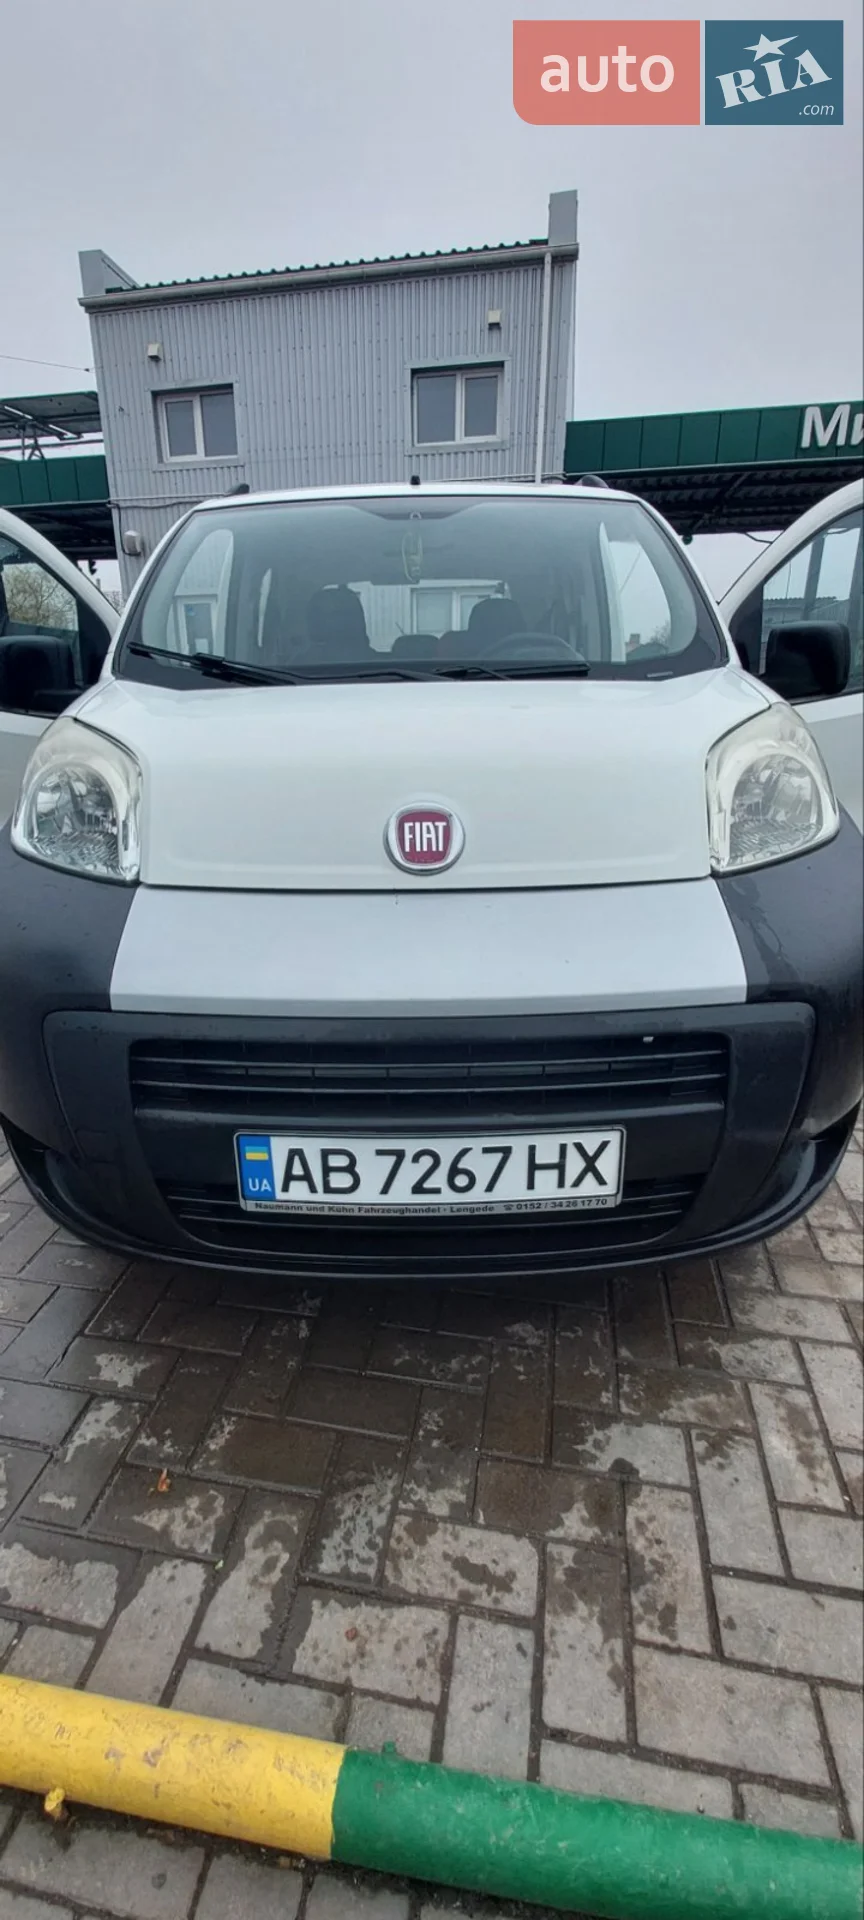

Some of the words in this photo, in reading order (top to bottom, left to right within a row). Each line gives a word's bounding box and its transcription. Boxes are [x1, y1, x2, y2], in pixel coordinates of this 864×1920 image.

[404, 821, 447, 852] FIAT
[281, 1148, 361, 1194] AB
[375, 1146, 513, 1195] 7267
[526, 1140, 610, 1190] HX
[248, 1178, 272, 1192] UA
[255, 1202, 303, 1212] Naumann
[306, 1205, 325, 1213] und
[357, 1206, 441, 1215] Fahrzeughandel
[449, 1204, 495, 1214] Lengede
[516, 1202, 542, 1211] 0152
[580, 1199, 592, 1207] 17
[594, 1198, 608, 1206] 70
